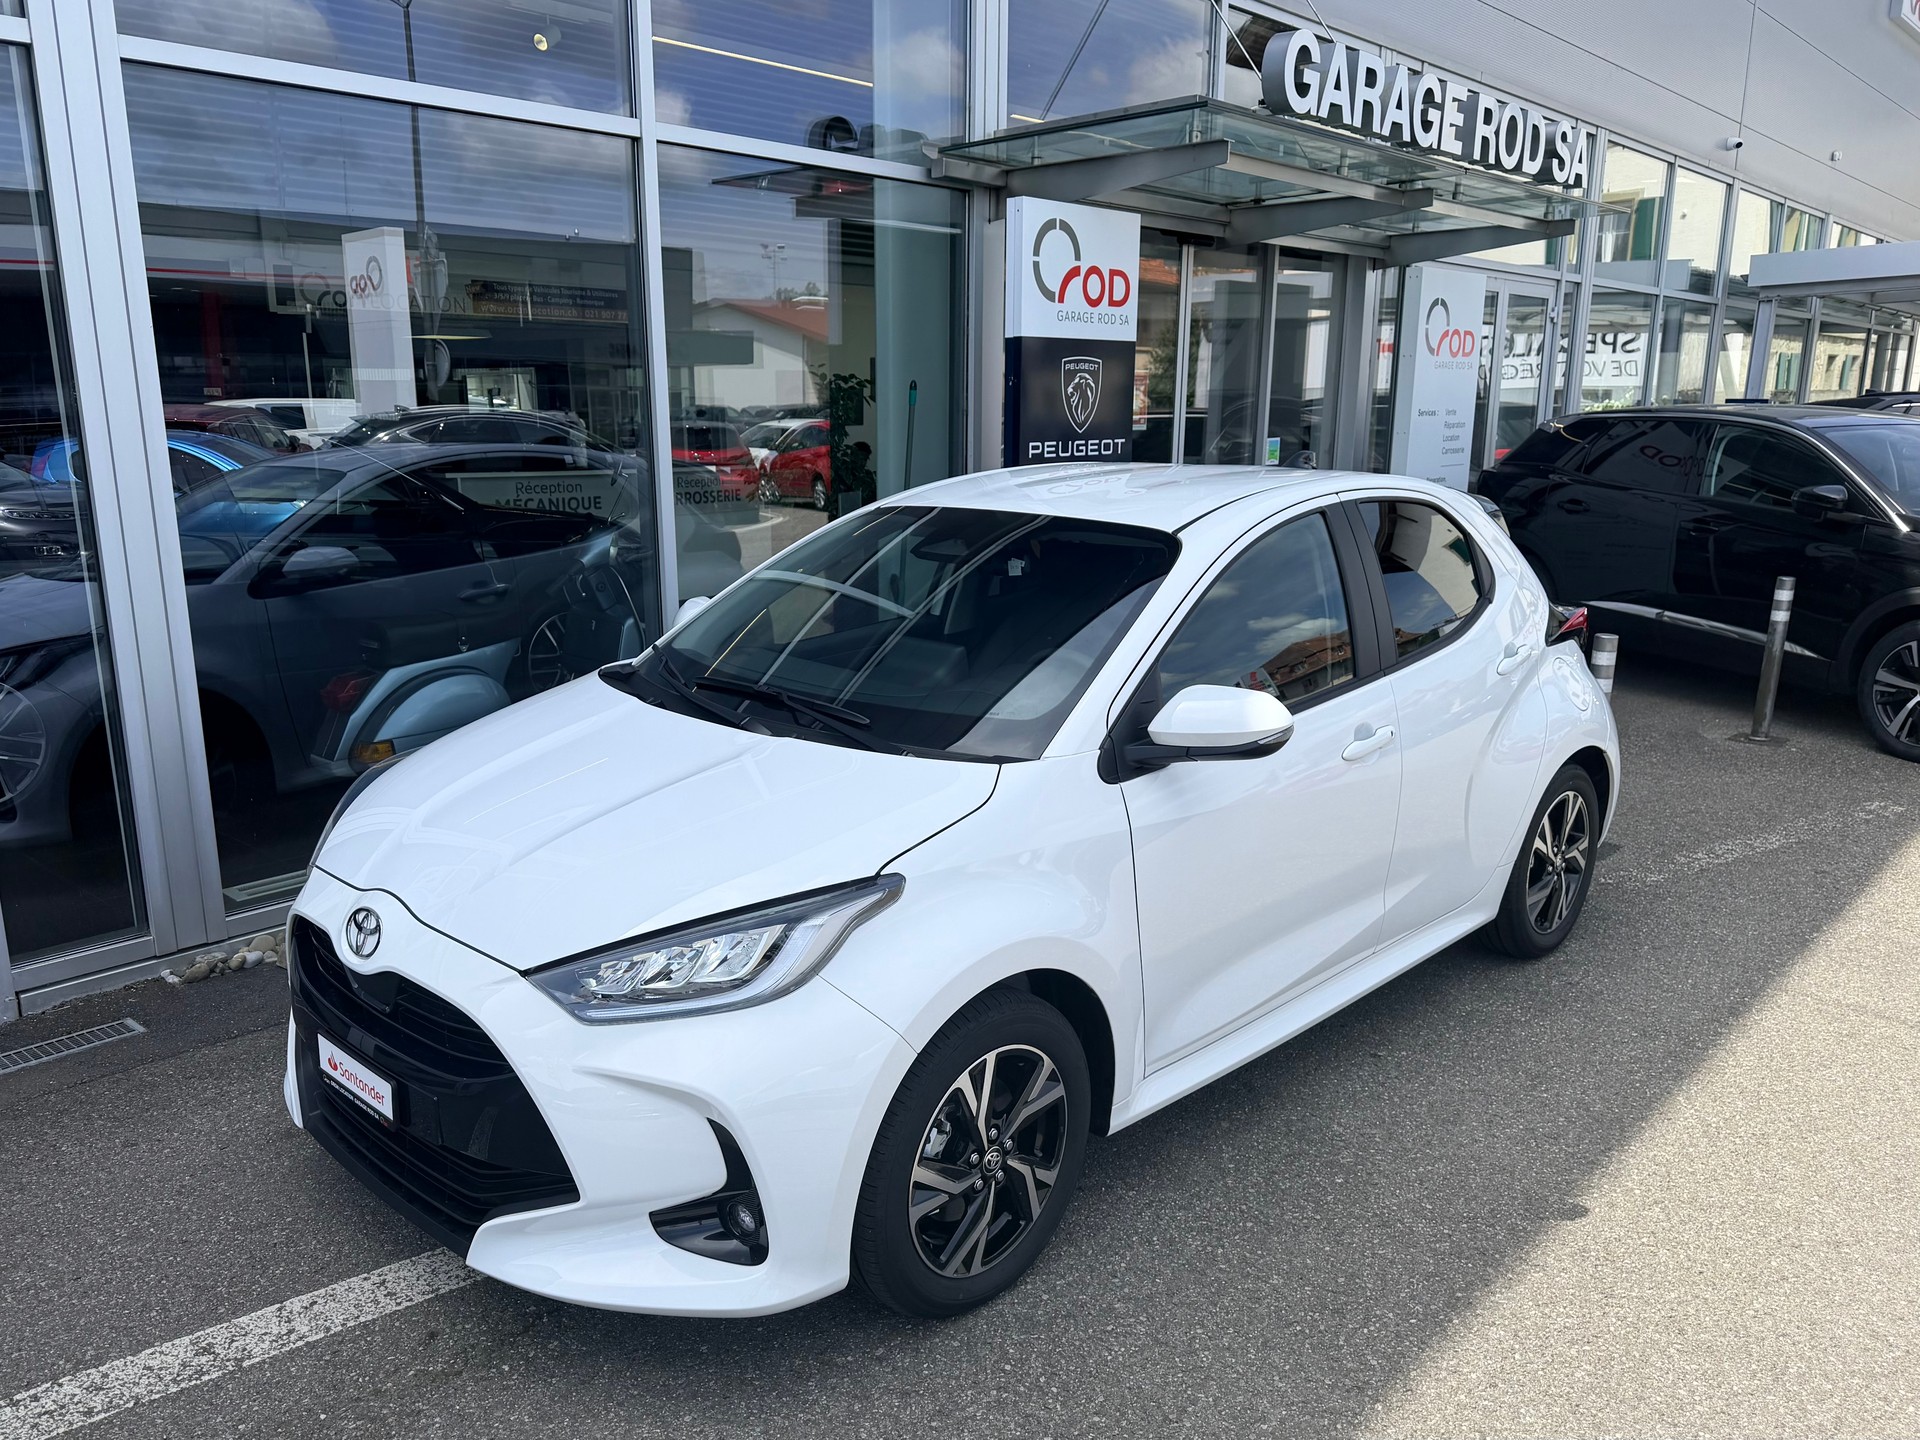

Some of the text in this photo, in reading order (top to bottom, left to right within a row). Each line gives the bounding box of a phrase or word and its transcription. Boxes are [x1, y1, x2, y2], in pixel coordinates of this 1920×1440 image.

[1284, 28, 1588, 189] GARAGE ROD SA
[1056, 310, 1130, 326] GARAGE ROD SA
[1065, 362, 1099, 371] PEUGEOT
[1443, 434, 1460, 442] Location
[1028, 438, 1126, 459] PEUGEOT
[515, 481, 583, 496] Réception
[677, 476, 724, 489] Réception
[339, 1061, 385, 1106] Santander
